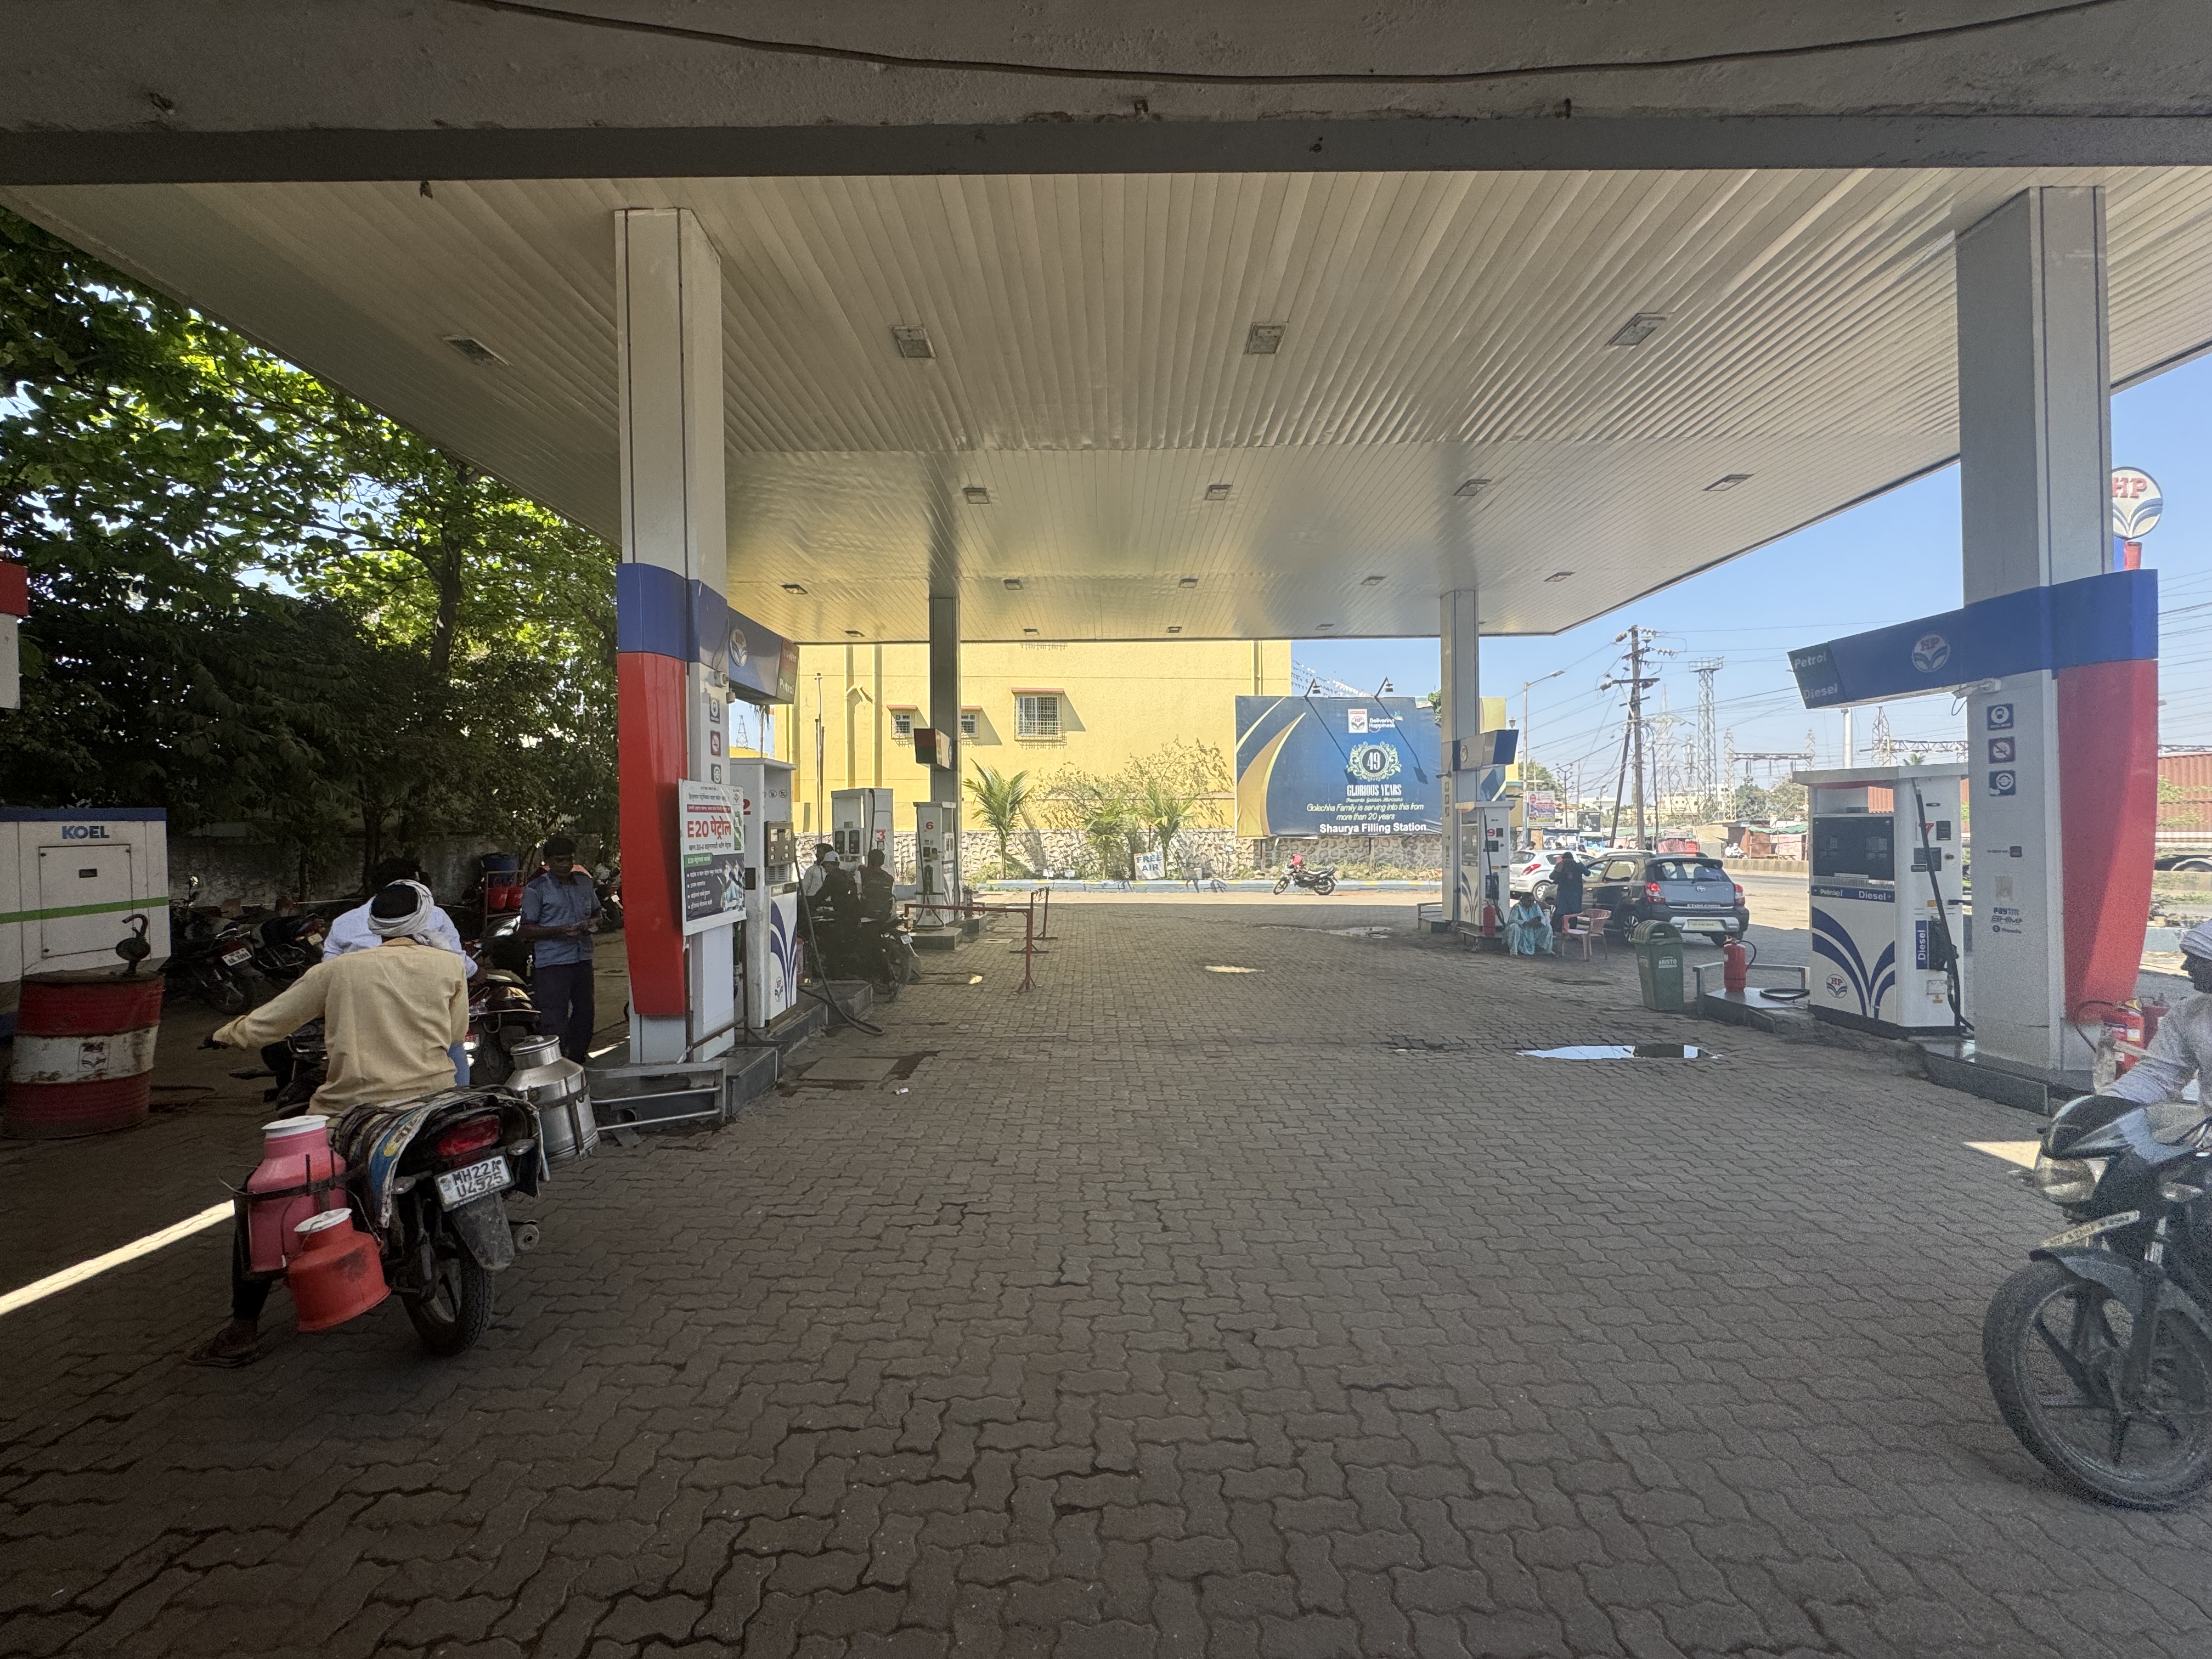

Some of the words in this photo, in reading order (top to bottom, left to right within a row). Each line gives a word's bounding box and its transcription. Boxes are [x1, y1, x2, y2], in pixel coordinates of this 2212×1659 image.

[2112, 477, 2147, 499] HP
[1794, 651, 1826, 669] Petrol
[780, 678, 794, 695] Petrol
[1803, 683, 1838, 700] Diesel
[1367, 752, 1380, 770] 49
[1346, 785, 1379, 797] GLORIOUS
[1380, 784, 1402, 796] YEARS
[1336, 803, 1357, 812] Family
[1364, 803, 1386, 812] serving
[1386, 803, 1398, 811] into
[1398, 803, 1410, 811] this
[1410, 802, 1424, 810] from
[1378, 814, 1395, 822] years
[61, 825, 110, 839] KOEL
[687, 820, 709, 838] E20
[710, 815, 731, 840] पेट्रोल
[926, 821, 934, 830] 6
[1319, 823, 1359, 834] Shaurya
[1362, 823, 1391, 834] Filling
[1393, 822, 1427, 832] Station
[876, 830, 886, 840] 3
[1136, 854, 1162, 864] FREE
[1142, 864, 1159, 872] AIR
[1858, 890, 1886, 901] Diesel
[1917, 929, 1926, 960] Diesel
[1831, 977, 1843, 986] HP
[452, 1160, 500, 1186] MH22A
[456, 1171, 504, 1198] U4525
